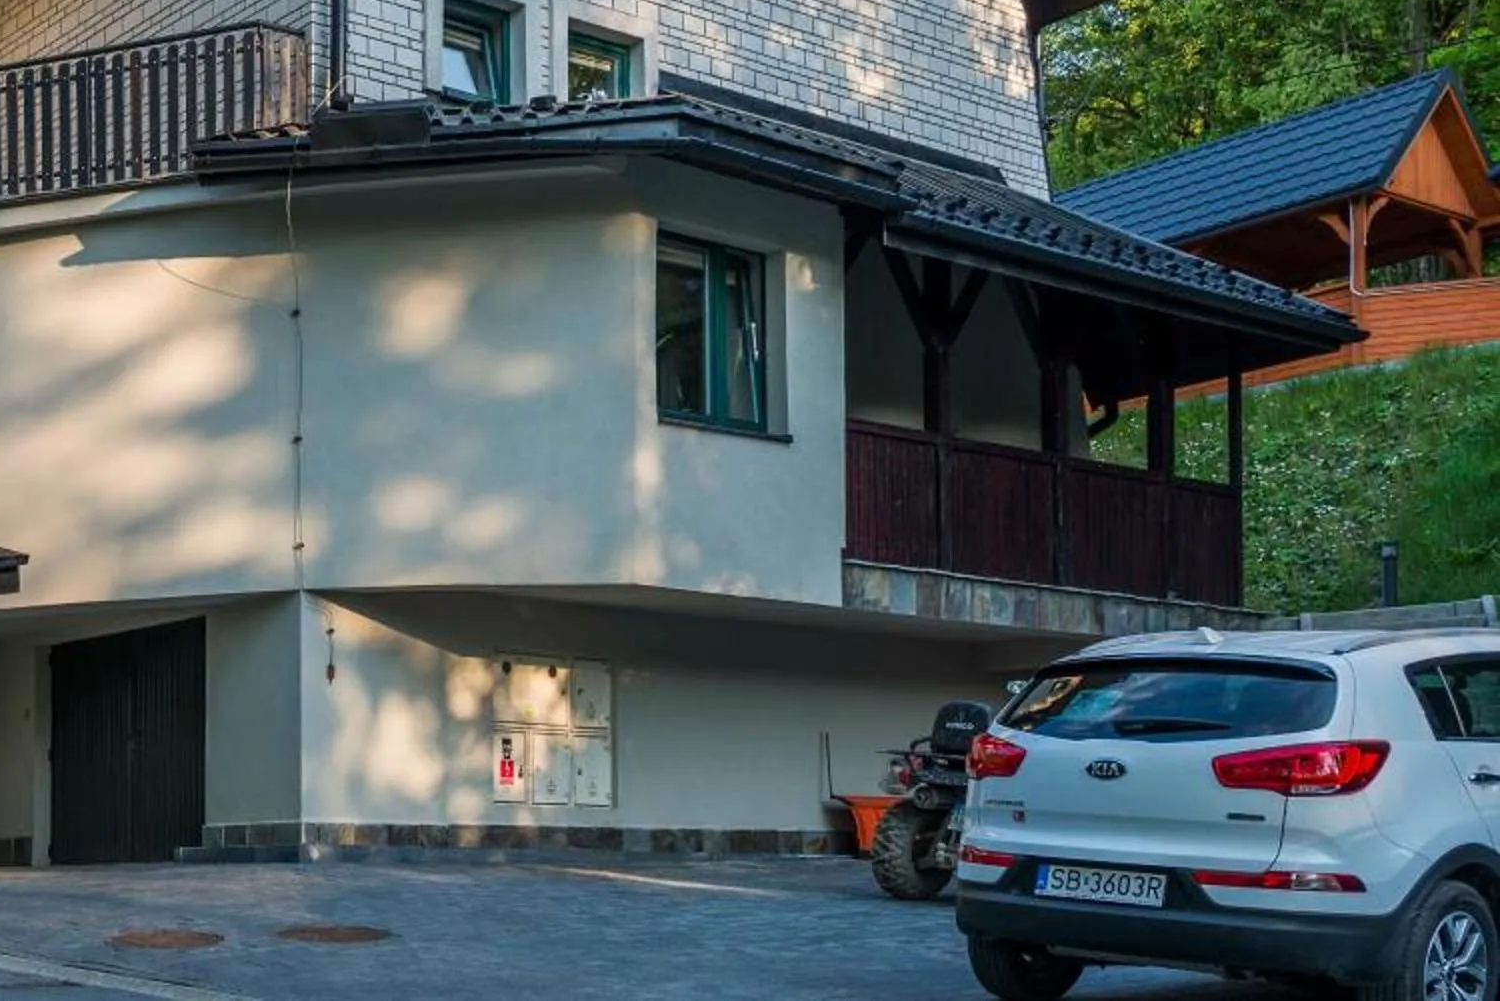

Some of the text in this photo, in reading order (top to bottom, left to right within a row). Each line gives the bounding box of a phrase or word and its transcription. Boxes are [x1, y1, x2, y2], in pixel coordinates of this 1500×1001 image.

[1091, 761, 1121, 776] KIA
[1050, 868, 1163, 900] SB 3603R
